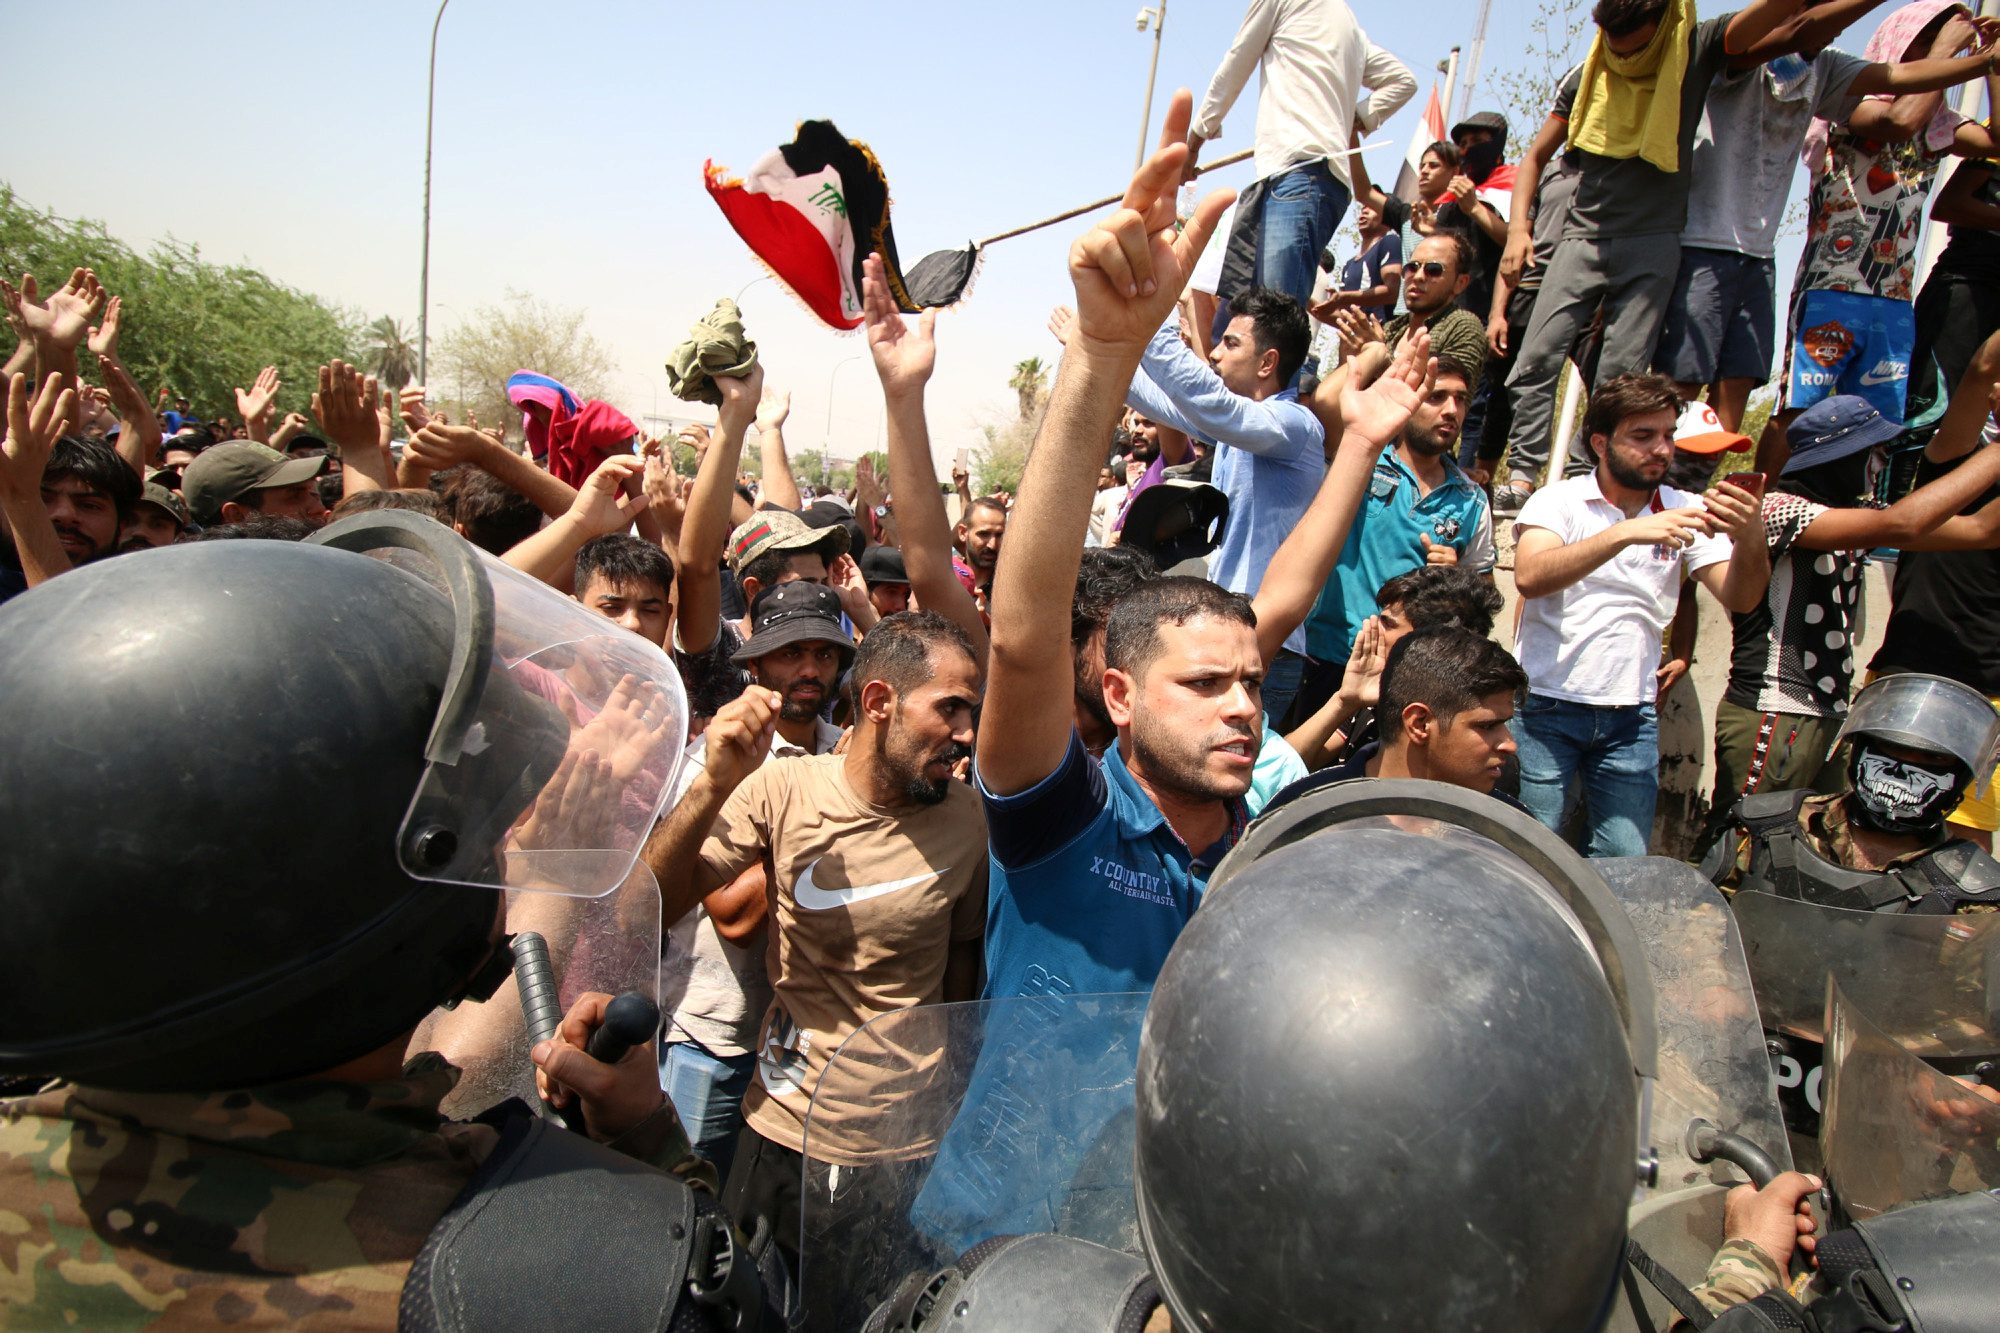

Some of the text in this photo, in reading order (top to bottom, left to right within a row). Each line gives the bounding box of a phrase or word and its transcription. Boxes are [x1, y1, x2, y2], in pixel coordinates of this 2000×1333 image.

[1872, 361, 1907, 376] NIKE
[1090, 856, 1103, 874] X
[1104, 861, 1160, 893] COUNTRY
[1108, 880, 1122, 892] ALL
[1151, 894, 1177, 907] MASTE
[800, 1040, 810, 1048] DO
